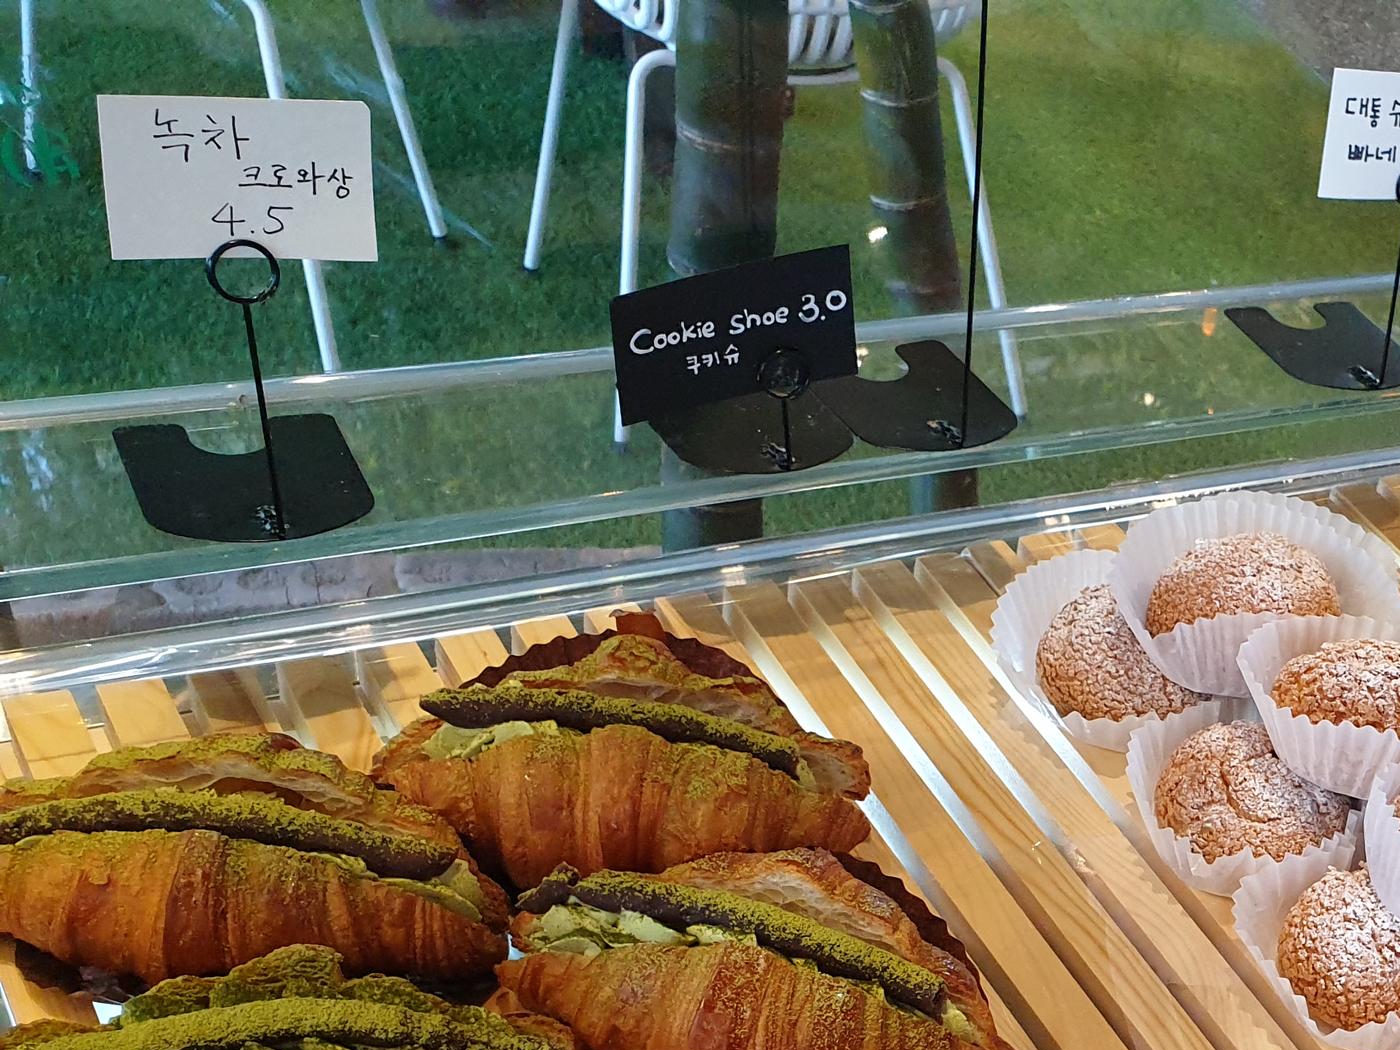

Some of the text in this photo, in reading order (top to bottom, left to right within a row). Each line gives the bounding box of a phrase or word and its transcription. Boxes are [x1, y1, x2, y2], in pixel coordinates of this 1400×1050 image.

[1344, 97, 1382, 128] 대통
[153, 108, 250, 162] 녹차
[1347, 143, 1398, 163] 빠네
[238, 161, 354, 199] 크로와상
[211, 202, 294, 236] 4.5
[629, 289, 847, 355] Cookie shoe 3.0
